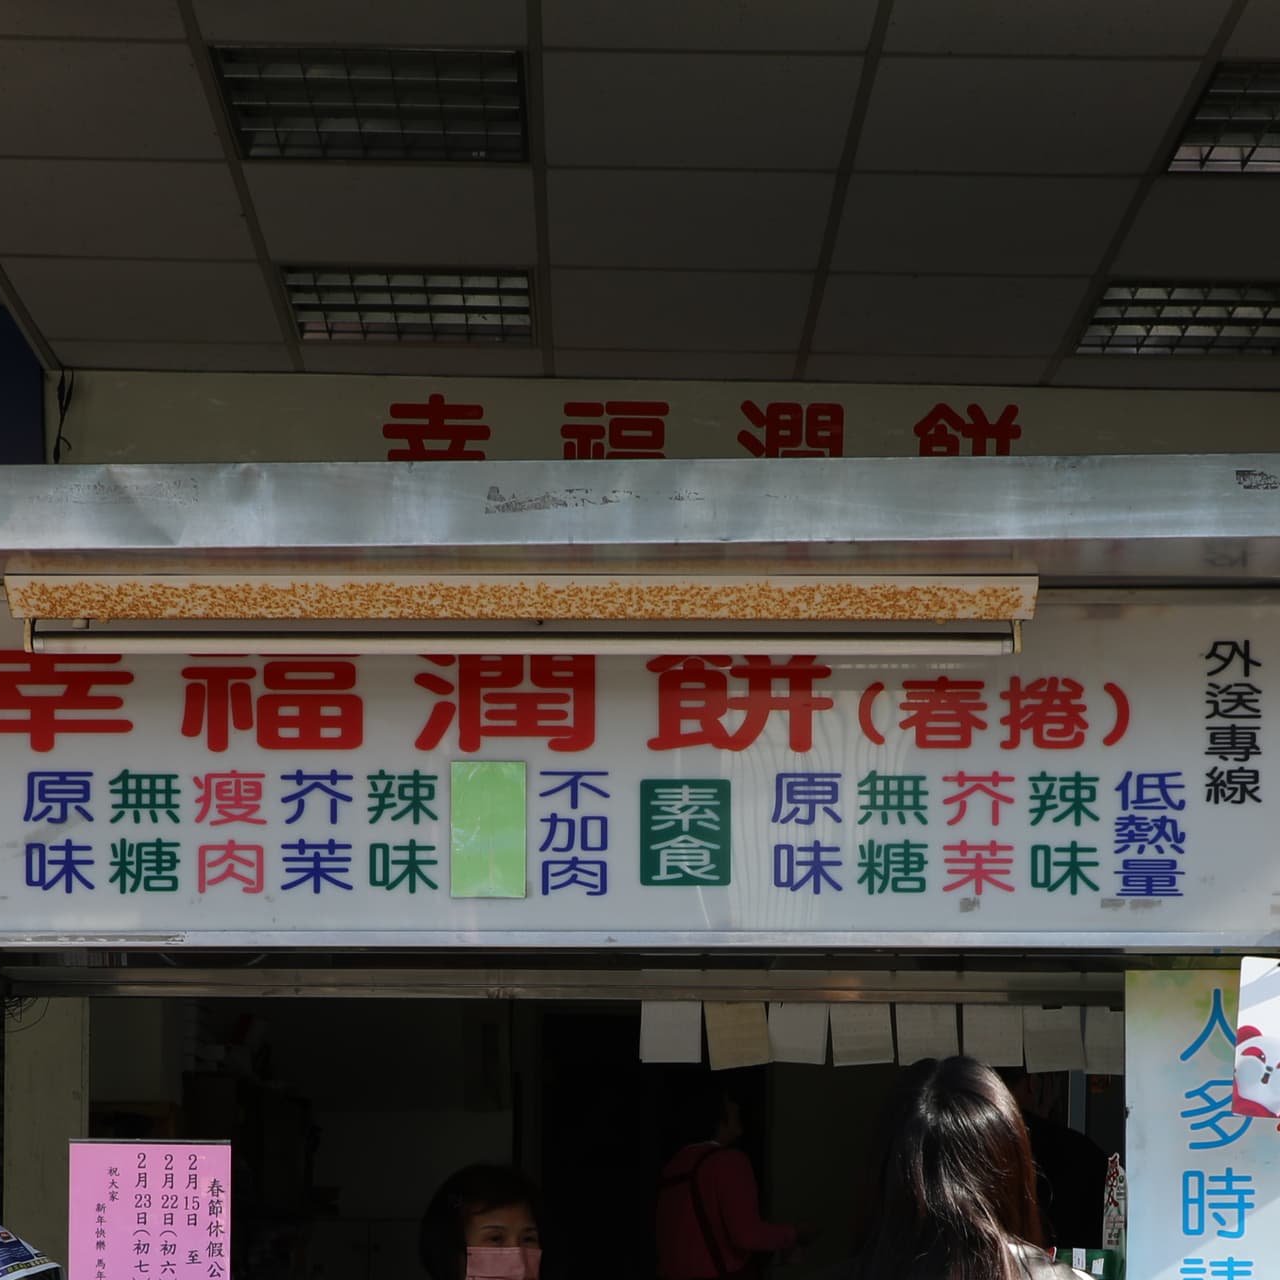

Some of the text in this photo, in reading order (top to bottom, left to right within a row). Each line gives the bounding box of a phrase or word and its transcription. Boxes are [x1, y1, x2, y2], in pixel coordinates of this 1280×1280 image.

[1204, 637, 1263, 805] 外送專線
[539, 769, 610, 897] 不加肉
[650, 785, 720, 881] 素食
[1114, 770, 1186, 898] 低熱量
[108, 1166, 120, 1202] 祝大家
